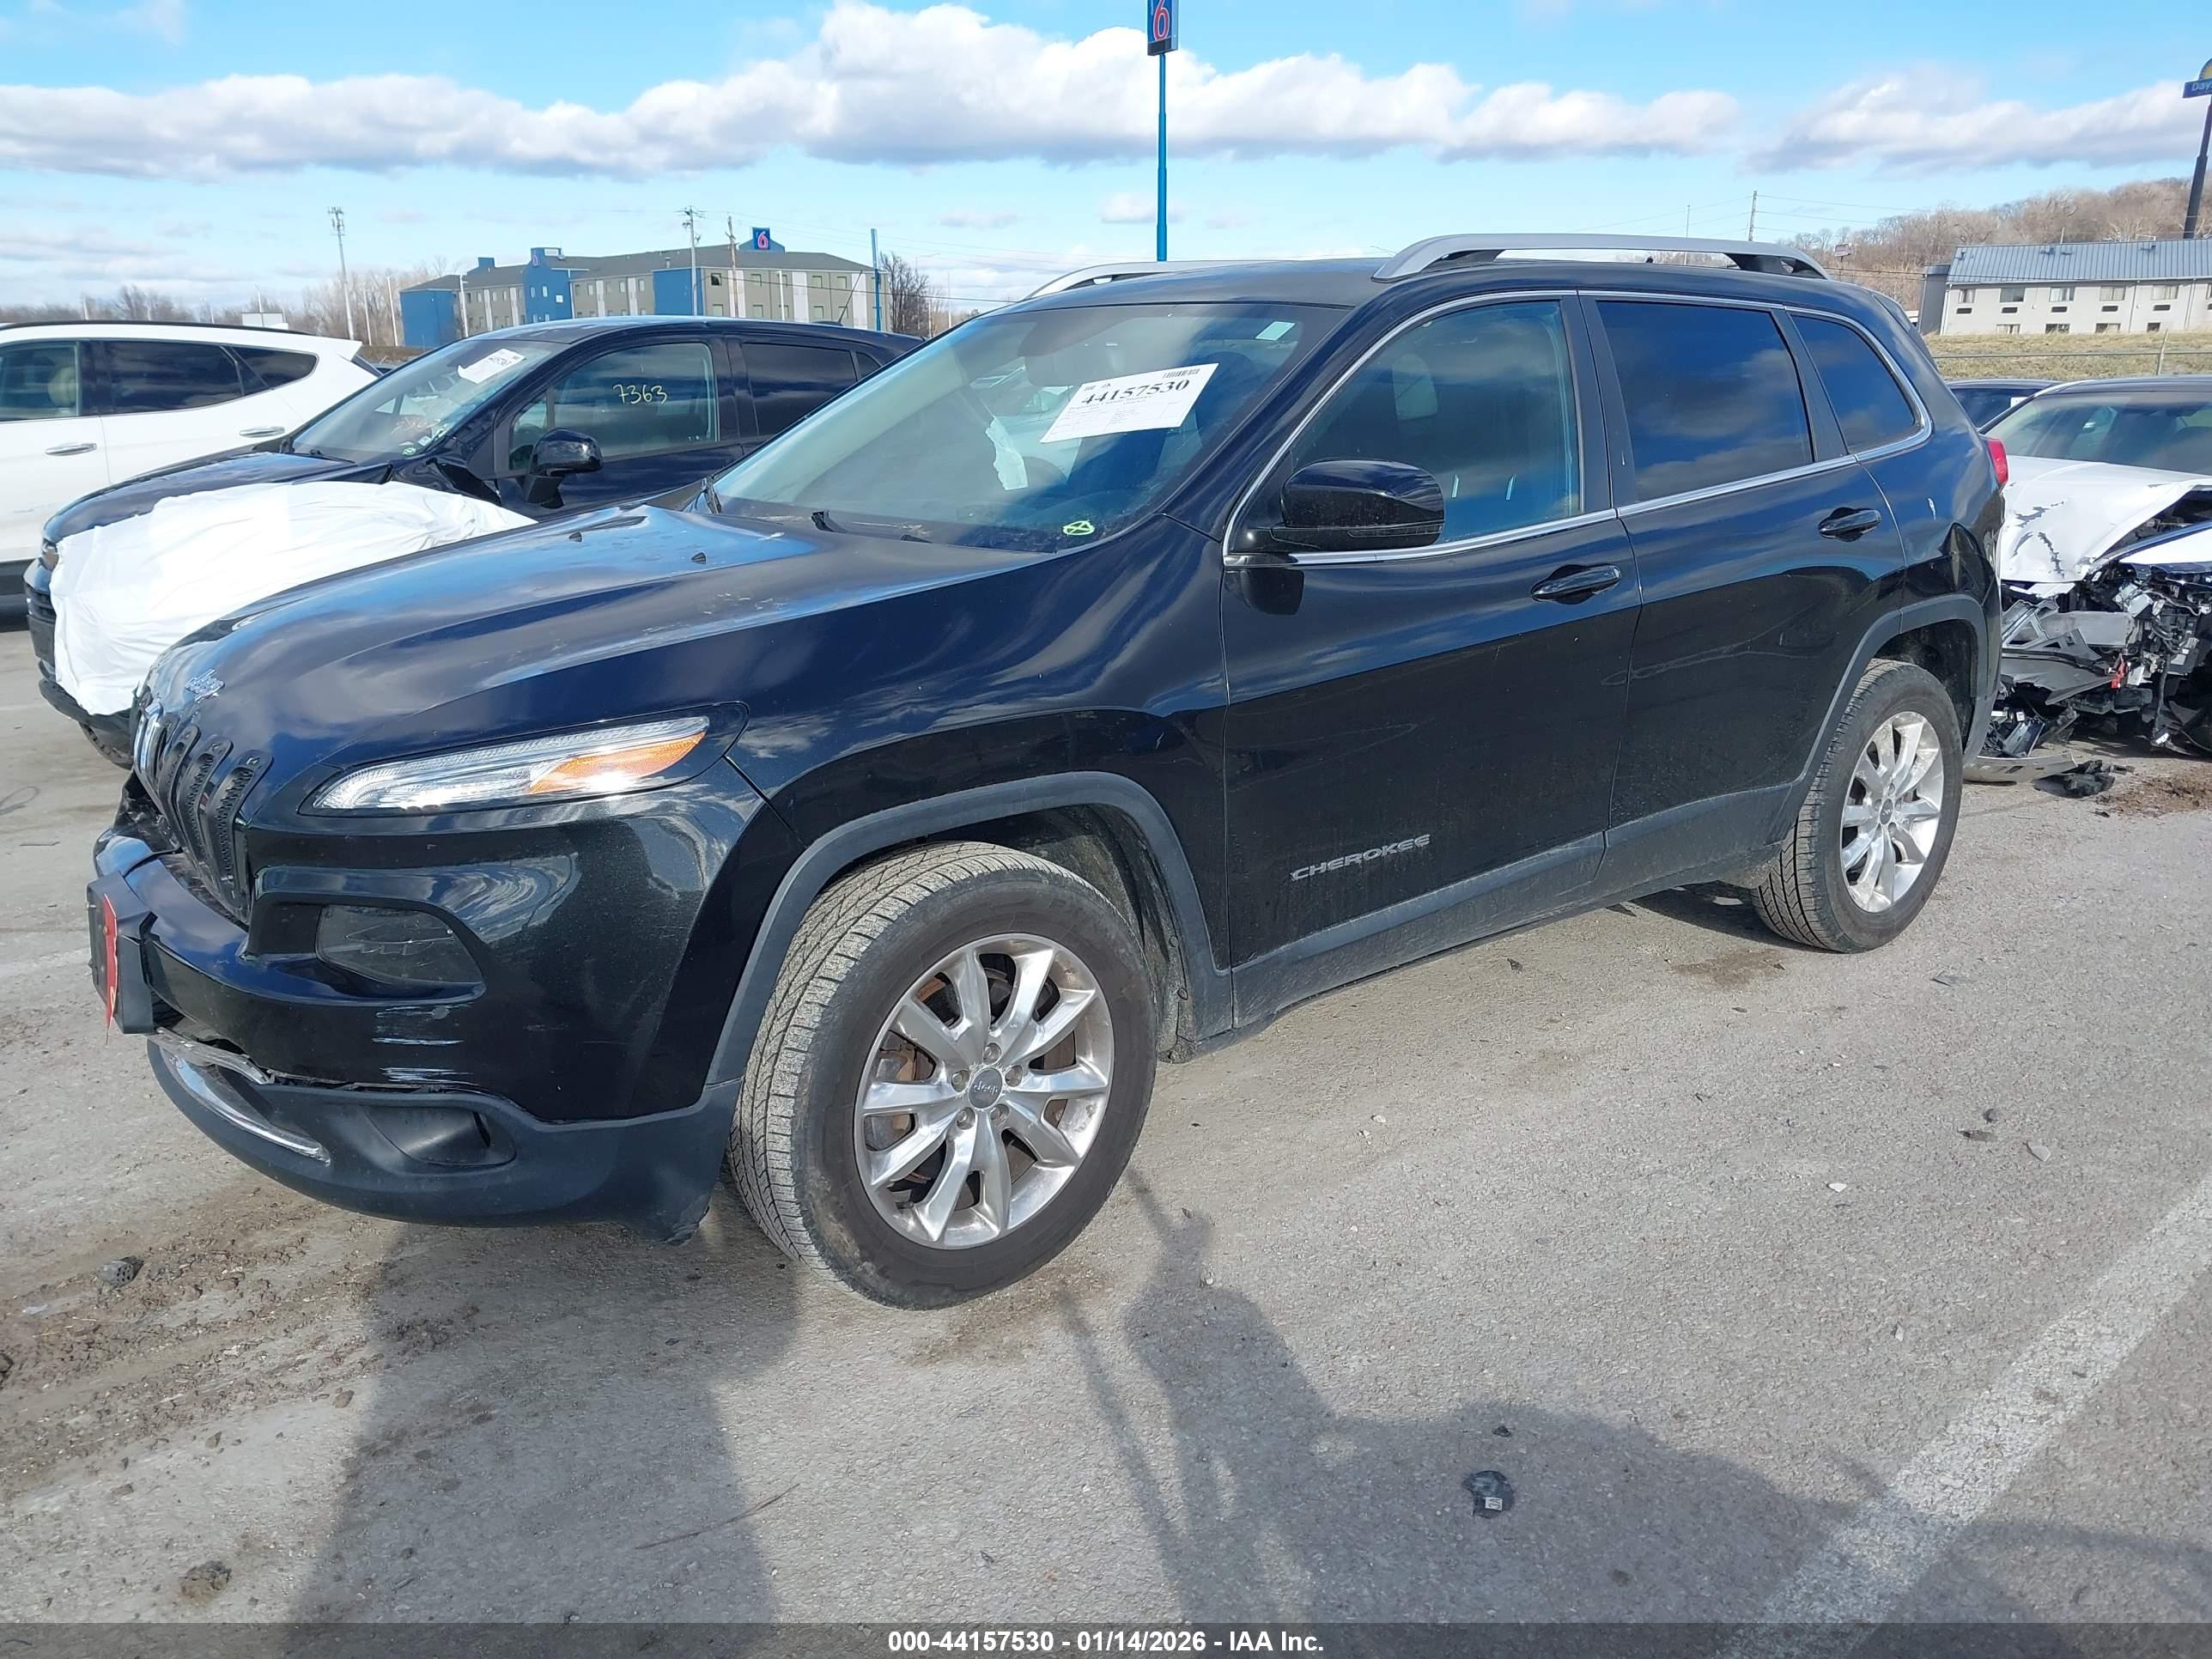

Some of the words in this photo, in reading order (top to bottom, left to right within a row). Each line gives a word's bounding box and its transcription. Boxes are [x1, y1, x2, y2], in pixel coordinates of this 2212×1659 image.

[1153, 0, 1170, 41] 6
[757, 230, 769, 249] 6
[612, 384, 668, 405] 7363
[1081, 379, 1190, 405] 44157530
[1290, 834, 1431, 882] CHEROKEE
